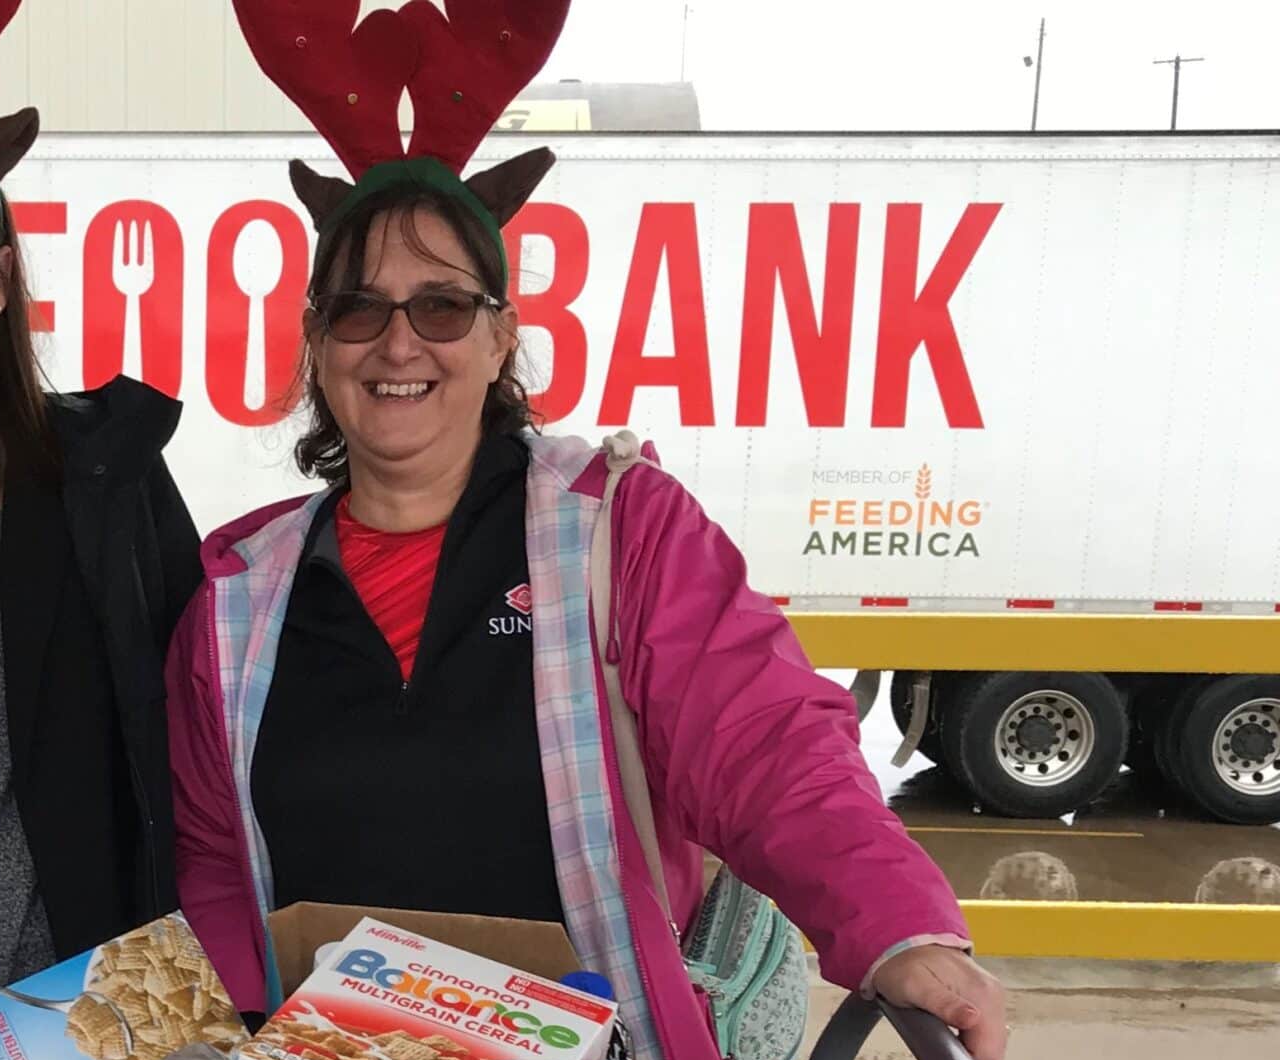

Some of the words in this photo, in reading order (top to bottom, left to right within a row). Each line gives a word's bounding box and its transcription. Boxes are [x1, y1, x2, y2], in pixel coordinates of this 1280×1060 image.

[10, 199, 310, 427] FOO
[512, 202, 1004, 429] BANK
[812, 470, 883, 484] MEMBER
[888, 470, 912, 484] OF
[808, 499, 983, 528] FEEDING
[802, 530, 980, 557] AMERICA
[365, 926, 427, 951] Millville
[335, 949, 582, 1049] Balance
[407, 962, 531, 1010] cinnamon
[340, 977, 462, 1025] MULTIGRAIN
[464, 1020, 544, 1055] CEREAL
